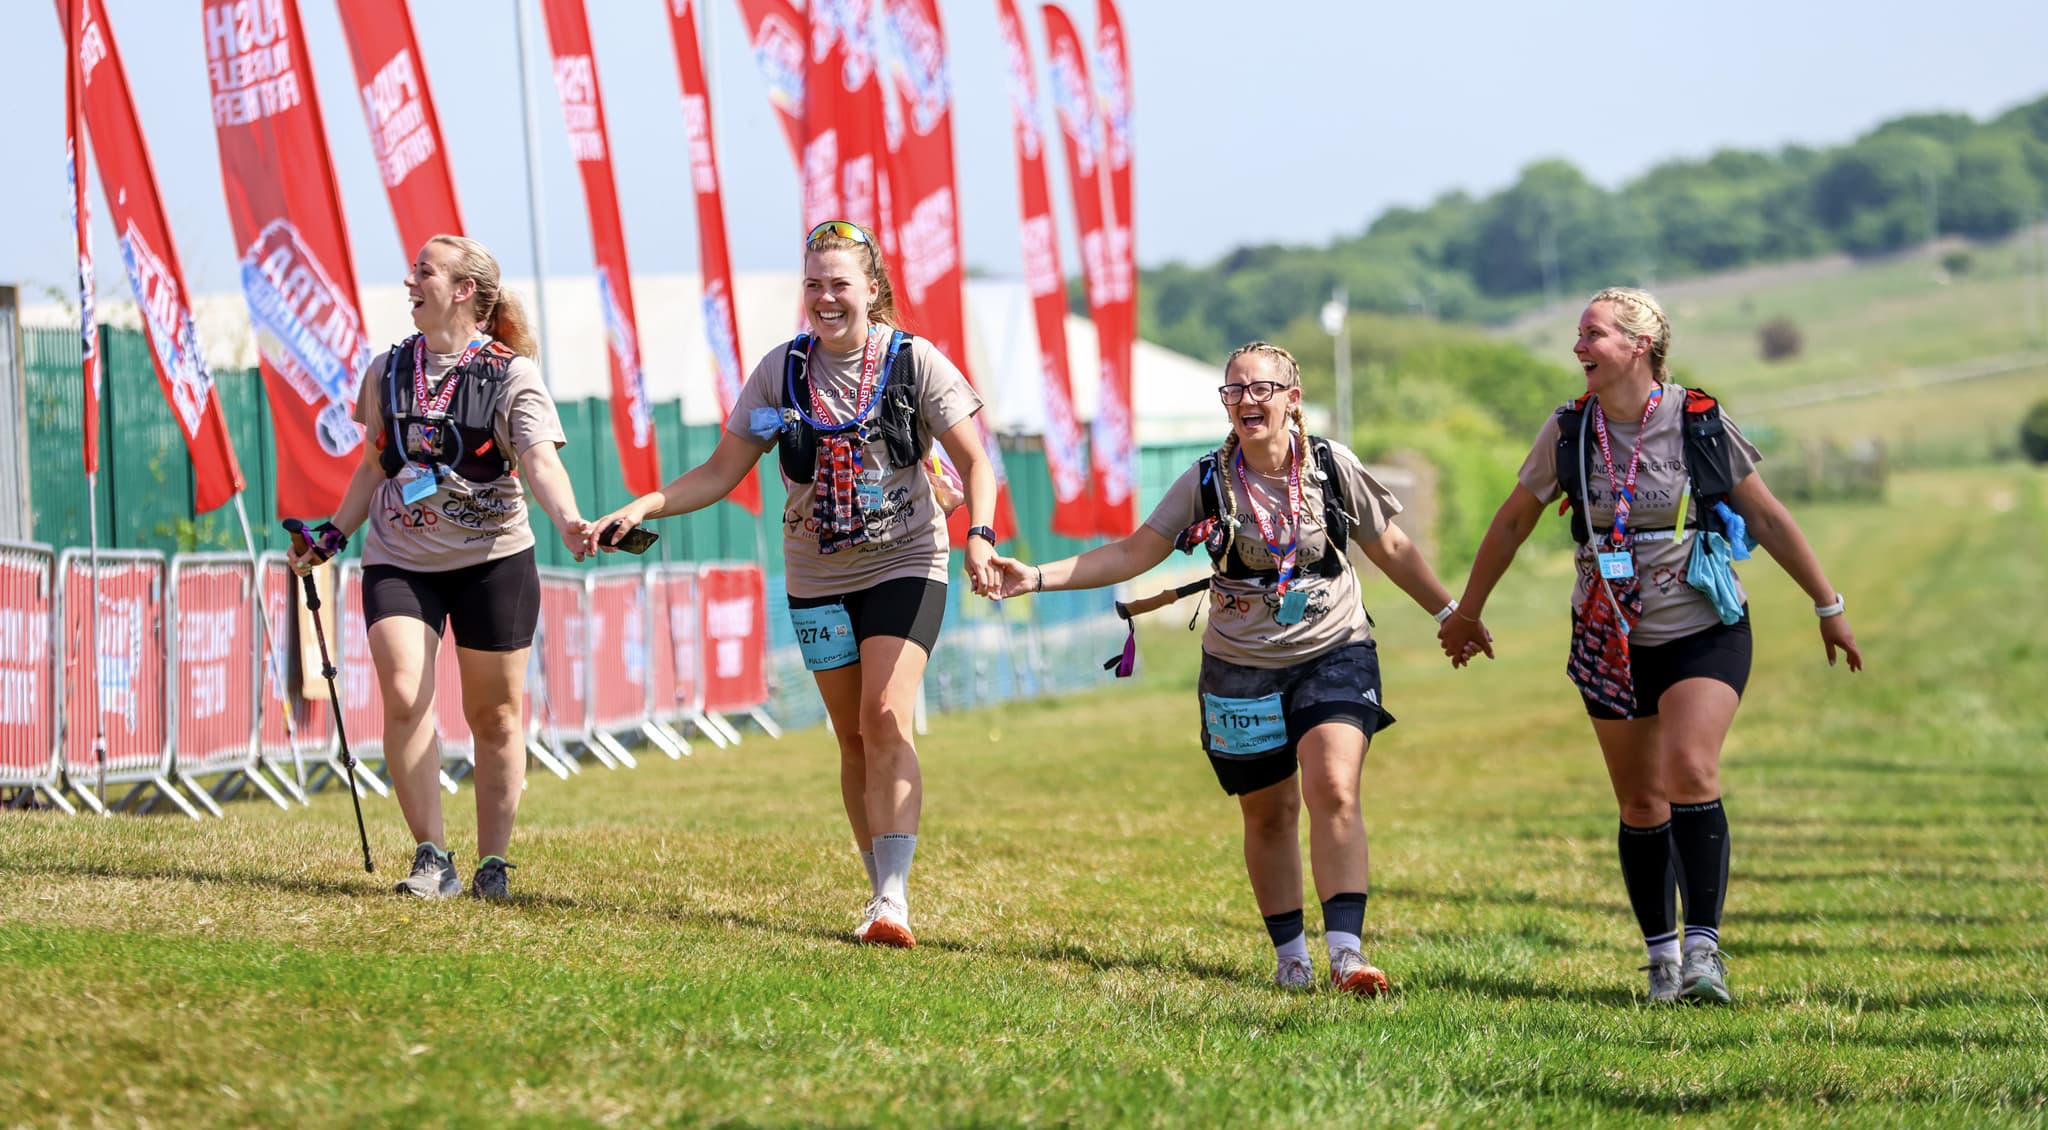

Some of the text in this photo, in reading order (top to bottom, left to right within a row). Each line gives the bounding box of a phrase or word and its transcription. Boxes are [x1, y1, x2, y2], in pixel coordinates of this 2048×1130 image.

[858, 336, 877, 418] 2026 CHALLENGE
[1220, 713, 1260, 728] 1101
